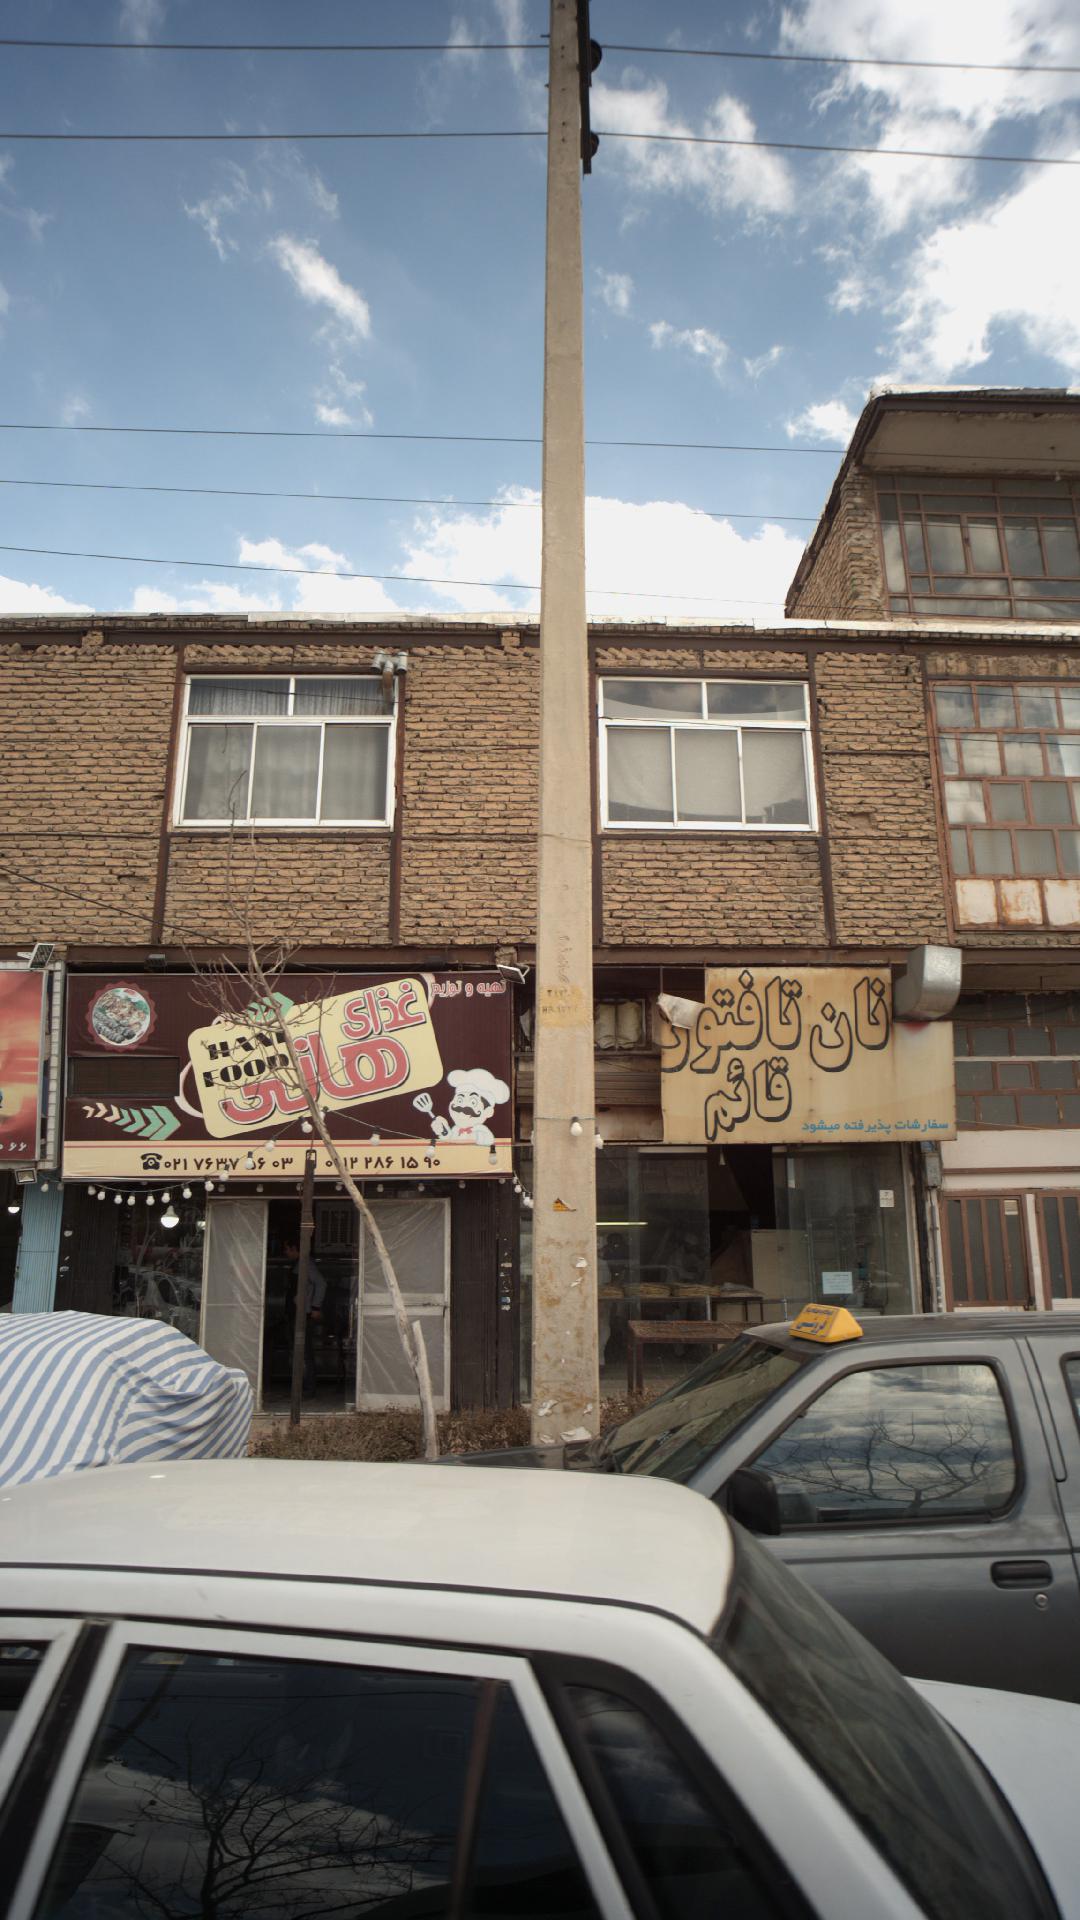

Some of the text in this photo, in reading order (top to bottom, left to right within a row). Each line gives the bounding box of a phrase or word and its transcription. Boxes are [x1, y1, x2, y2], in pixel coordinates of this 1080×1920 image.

[464, 982, 474, 997] و
[342, 981, 426, 1040] غذای
[809, 976, 890, 1073] نان
[202, 1053, 289, 1088] FOOD
[218, 1031, 410, 1125] هانی
[843, 1118, 892, 1135] پذیرفته
[895, 1118, 949, 1133] سفارشات
[164, 1157, 188, 1171] ۰۲۱
[272, 1156, 294, 1170] ۰۳
[325, 1155, 441, 1170] ۰۱۲ ۲۸۶ ۱۵ ۹۰
